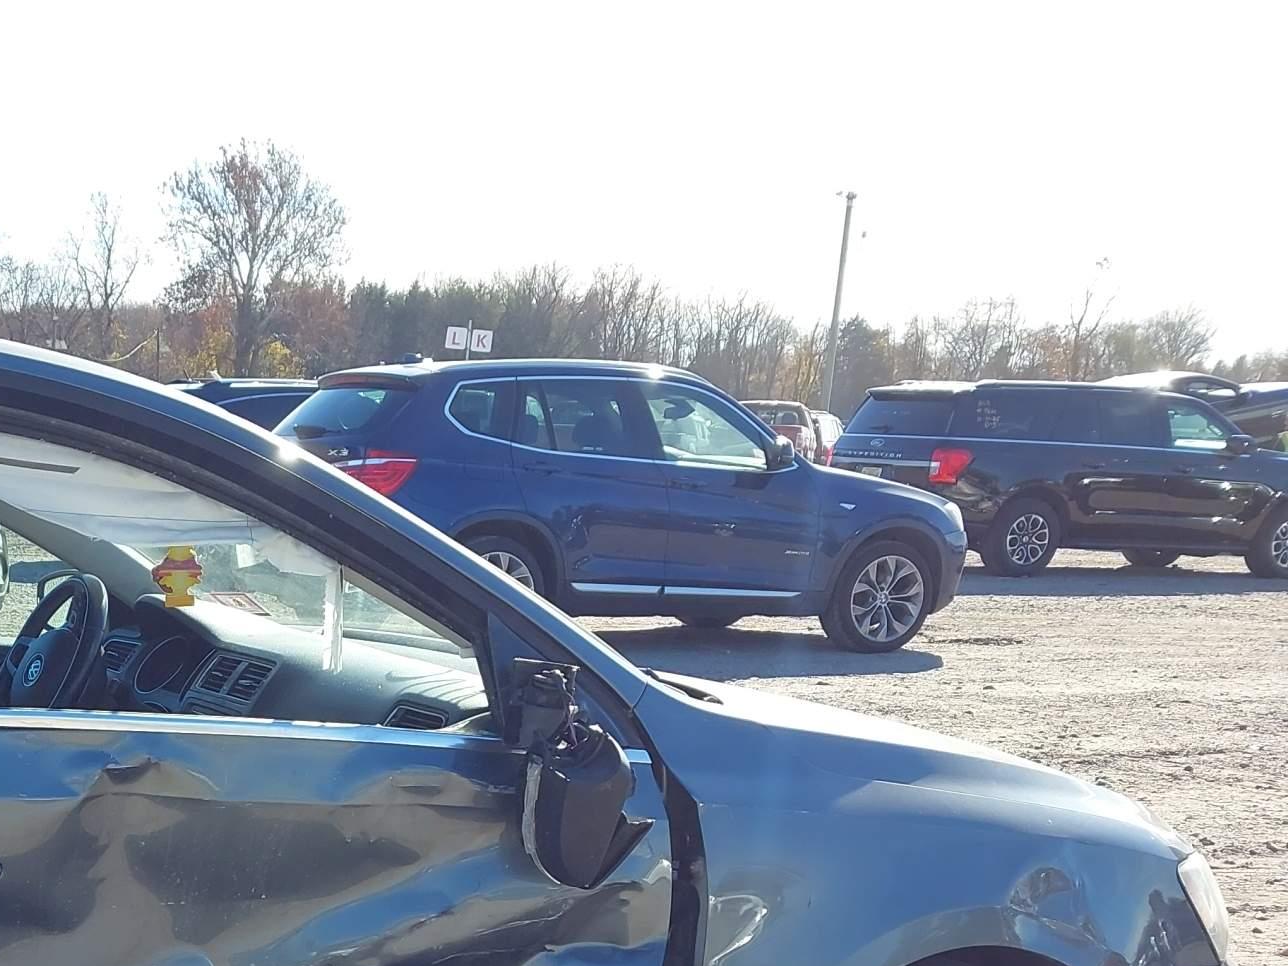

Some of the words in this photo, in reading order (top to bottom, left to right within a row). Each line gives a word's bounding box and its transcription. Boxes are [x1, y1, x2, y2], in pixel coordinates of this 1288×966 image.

[452, 331, 461, 345] L
[476, 334, 488, 348] K
[327, 448, 349, 456] X3
